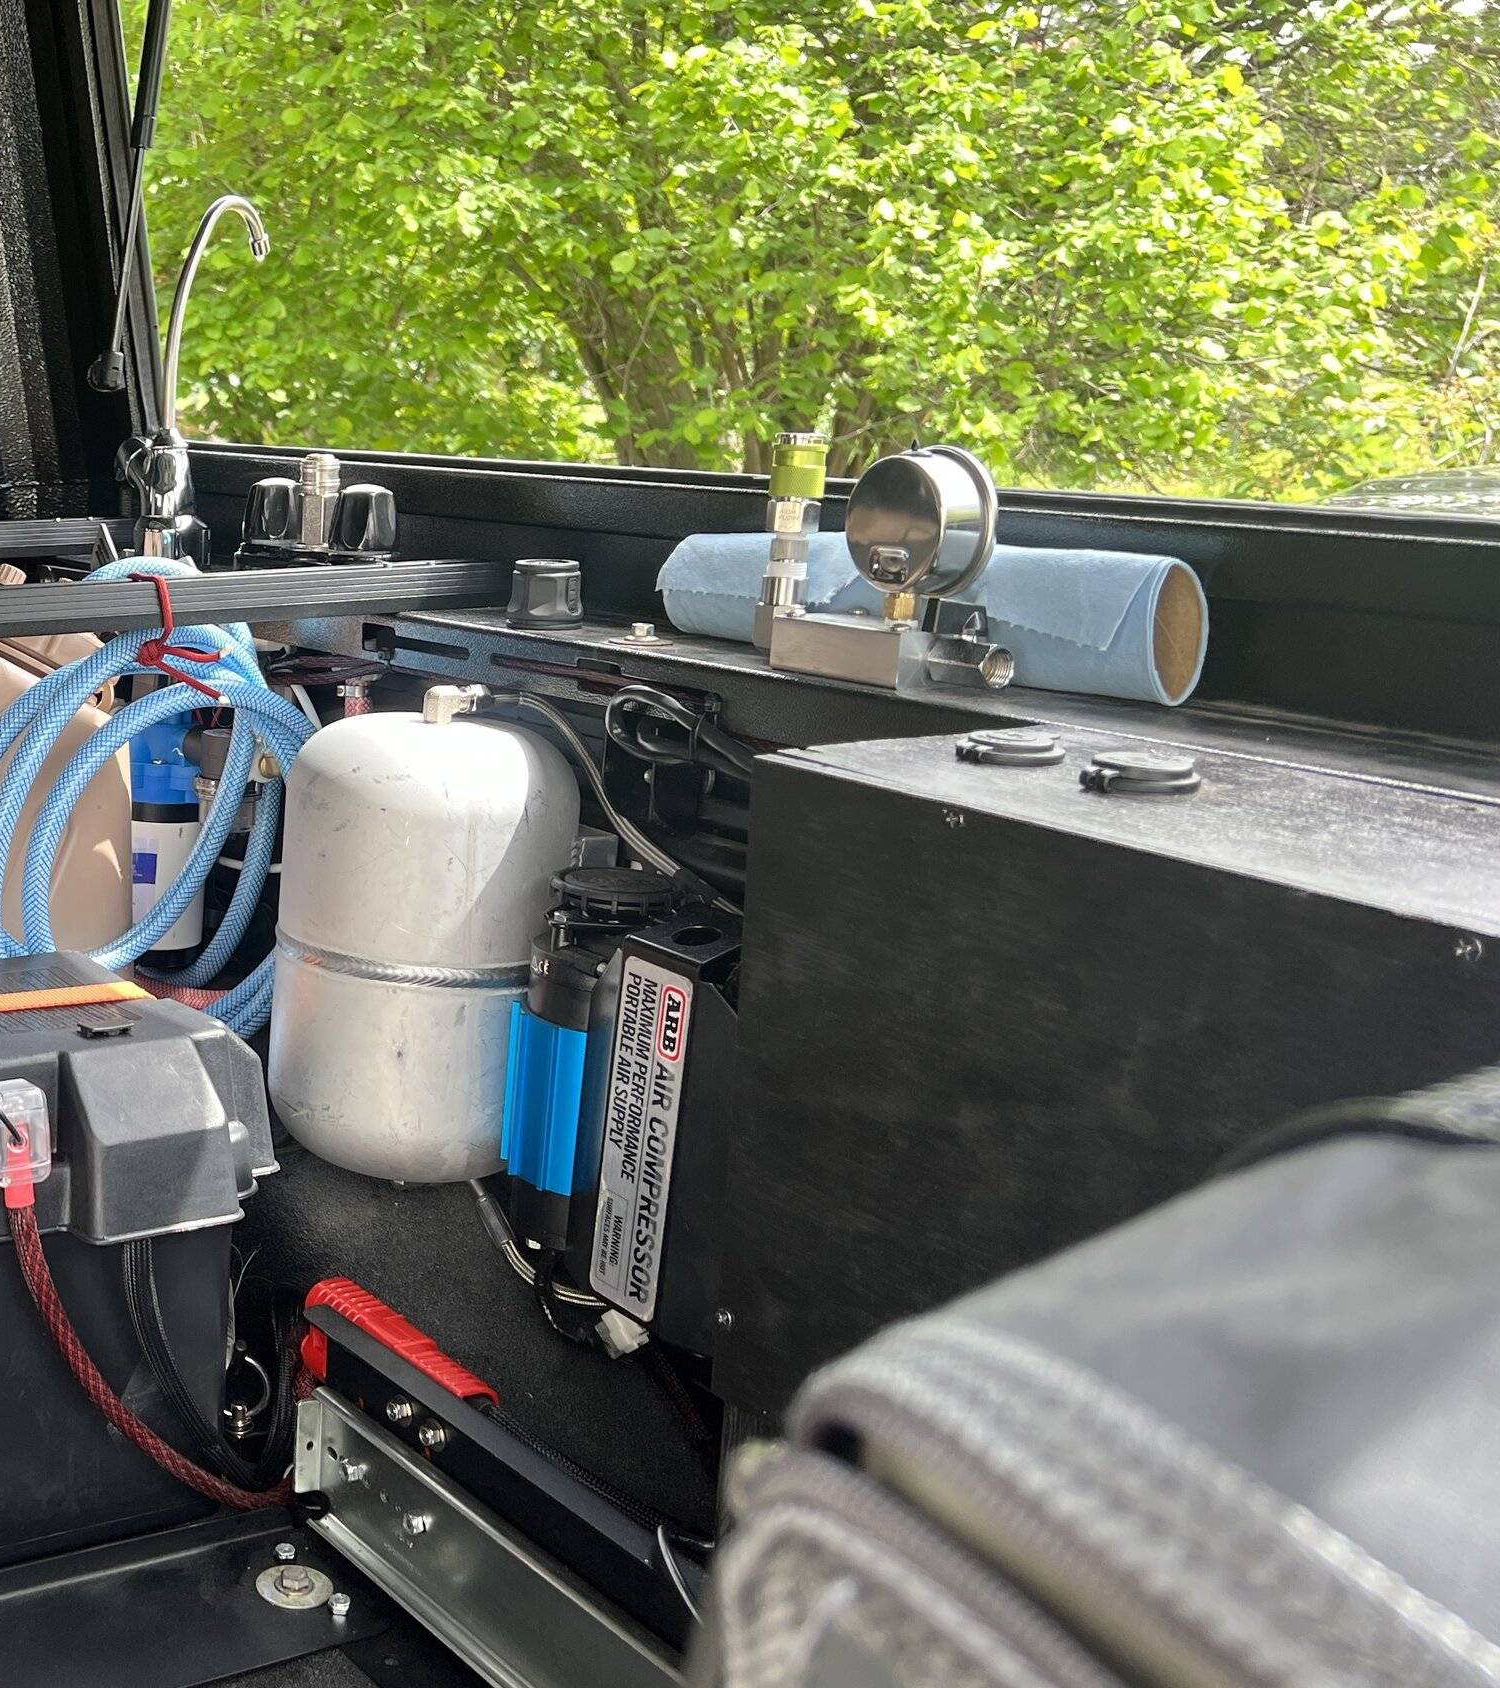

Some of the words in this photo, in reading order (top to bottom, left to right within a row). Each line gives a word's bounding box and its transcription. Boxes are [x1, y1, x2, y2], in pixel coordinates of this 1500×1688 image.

[619, 971, 642, 1056] PORTABLE
[635, 978, 658, 1061] MAXIMUM
[662, 993, 681, 1053] ARB
[615, 1056, 632, 1086] AIR
[651, 1061, 675, 1112] AIR
[609, 1086, 629, 1149] SUPPLY
[620, 1061, 648, 1184] PERFORMANCE
[609, 1215, 623, 1267] WARNING:
[628, 1116, 669, 1304] COMPRESSOR
